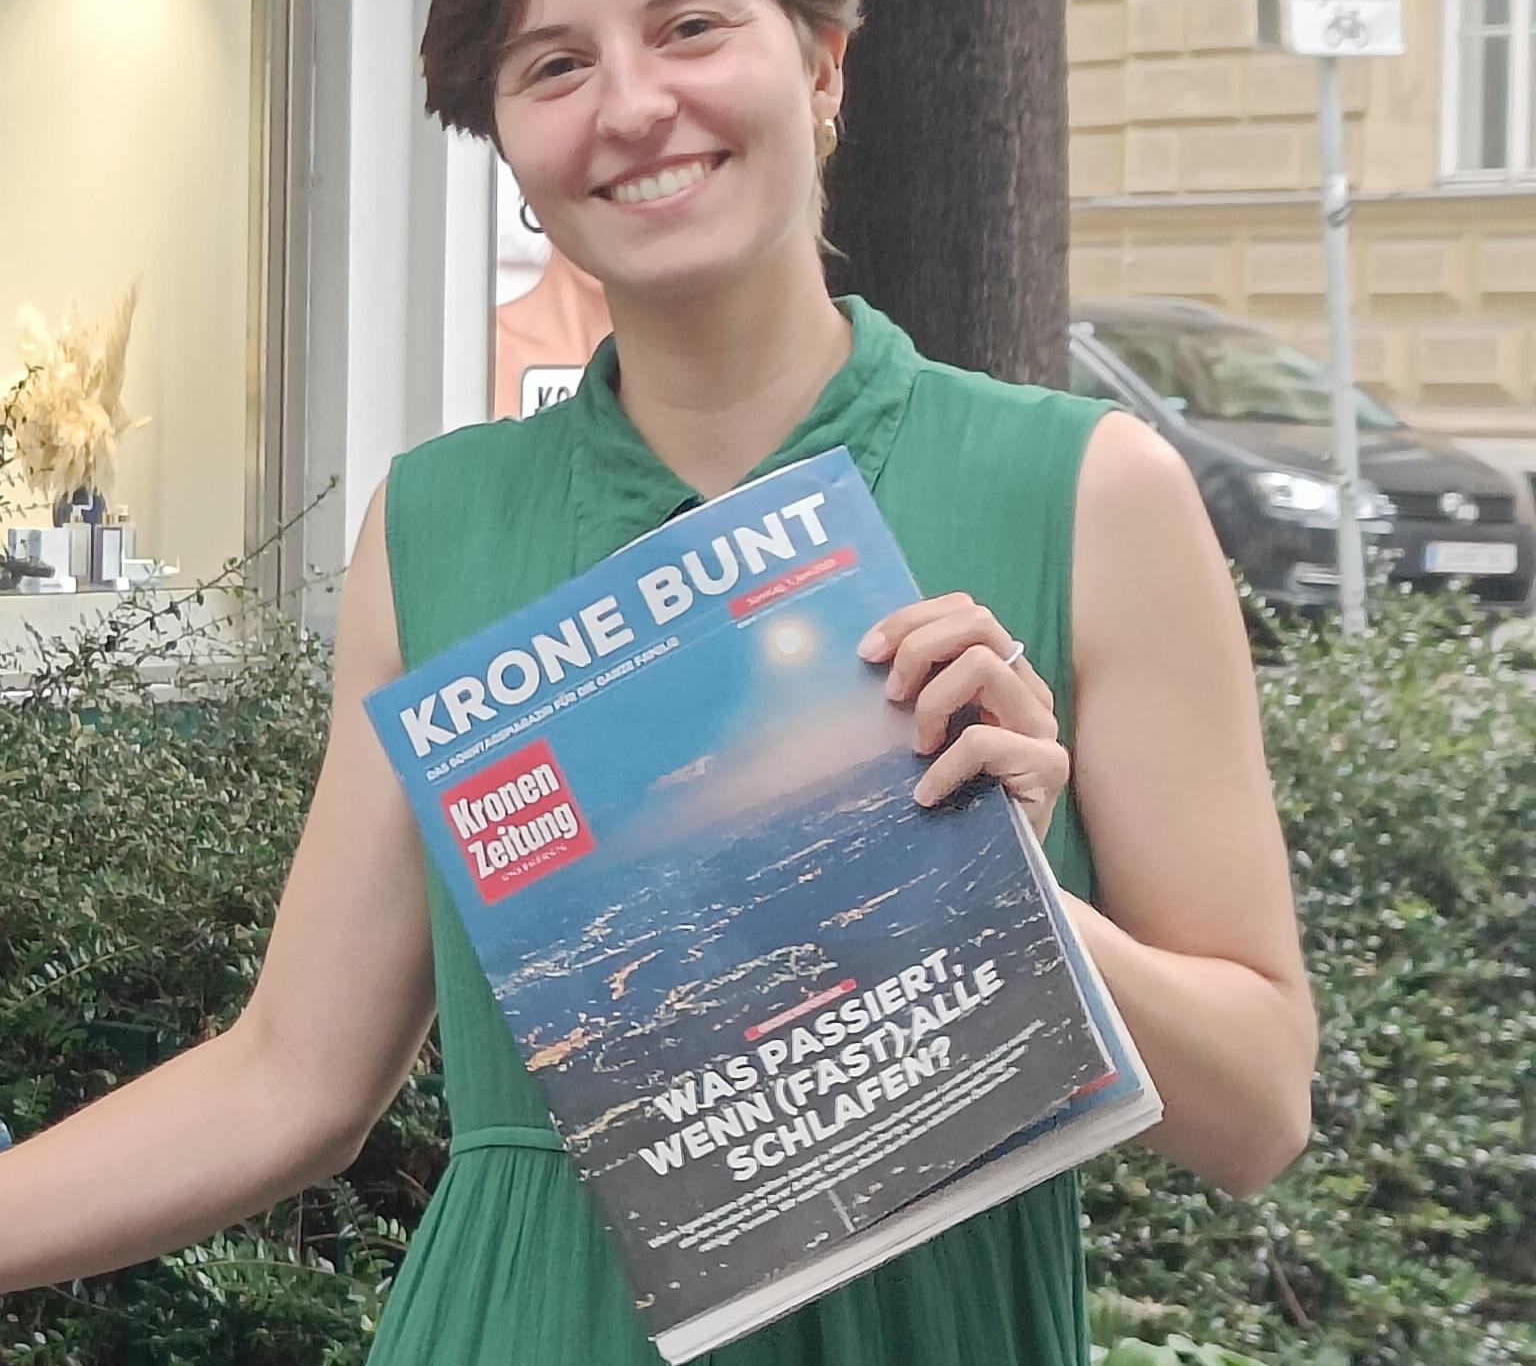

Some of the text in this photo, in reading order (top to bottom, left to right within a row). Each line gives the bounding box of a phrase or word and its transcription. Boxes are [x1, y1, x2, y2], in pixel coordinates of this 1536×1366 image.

[399, 595, 636, 759] KRONE
[636, 491, 830, 626] BUNT
[449, 762, 561, 840] Kronen
[467, 802, 579, 880] Zeitung
[637, 1091, 774, 1177] WENN
[773, 1020, 907, 1117] (FAST)
[907, 959, 1007, 1043] ALLE
[653, 1054, 759, 1125] WAS
[756, 947, 964, 1077] PASSIERT,
[725, 1035, 953, 1183] SCHLAFEN?
